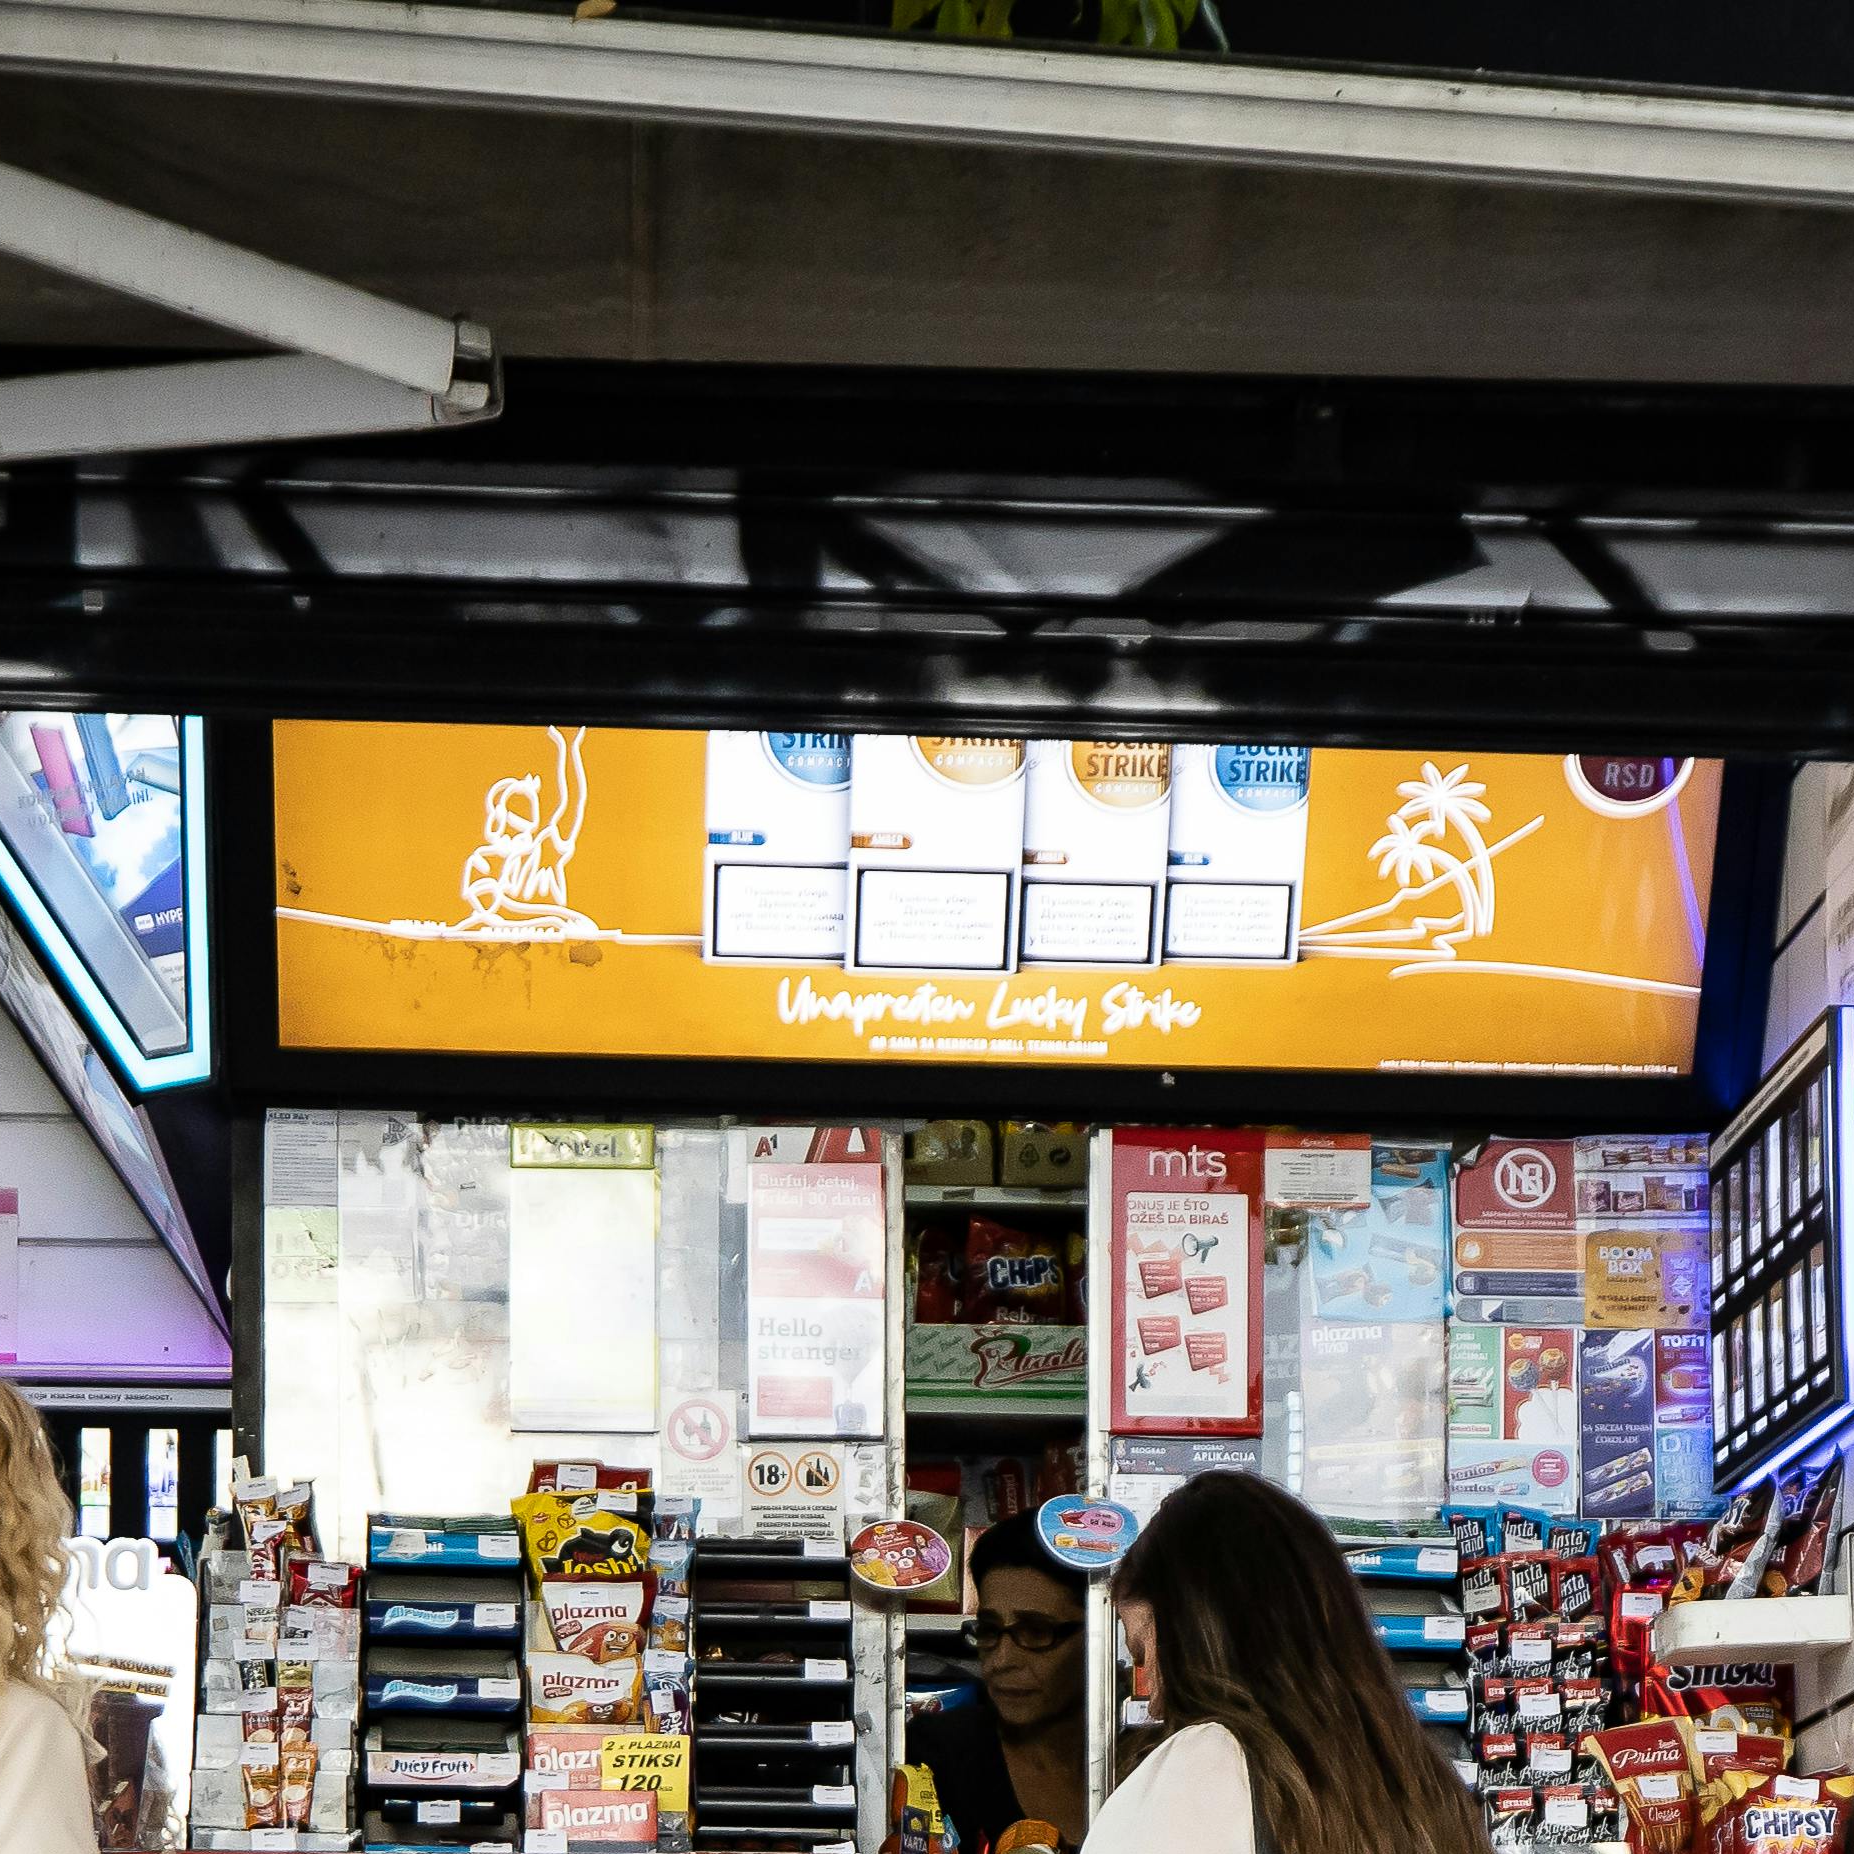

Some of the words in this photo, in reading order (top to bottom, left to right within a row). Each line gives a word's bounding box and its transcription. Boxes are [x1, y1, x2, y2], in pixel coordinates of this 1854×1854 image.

[1085, 755, 1168, 782] STRIKE
[1228, 758, 1307, 786] STRIKE
[1605, 761, 1656, 791] RSD
[987, 980, 1087, 1038] Lucky
[1102, 981, 1201, 1034] Strike
[755, 1134, 778, 1158] A1
[1149, 1144, 1227, 1178] mts
[808, 1192, 826, 1207] 30
[830, 1192, 878, 1207] dana!
[1167, 1201, 1180, 1211] JE
[1182, 1198, 1209, 1211] ŠTO
[1167, 1214, 1186, 1225] DA
[1189, 1212, 1229, 1225] BIRAŠ
[1608, 1261, 1643, 1275] BOX
[758, 1317, 823, 1339] Hello
[758, 1339, 864, 1364] stranger
[1595, 1424, 1624, 1432] SRCEM
[1193, 1451, 1256, 1462] APLIKACIJA
[755, 1463, 787, 1485] 18+
[1512, 1564, 1542, 1586] Insta
[552, 1604, 629, 1627] plazma
[542, 1672, 621, 1689] plazma
[605, 1740, 615, 1751] 2
[627, 1739, 682, 1750] PLAZMA
[613, 1753, 683, 1769] STIKSI
[1611, 1749, 1682, 1769] Prima
[618, 1775, 662, 1791] 120
[547, 1801, 649, 1832] plazma
[1648, 1807, 1682, 1822] Classic
[903, 1834, 928, 1853] VARTA
